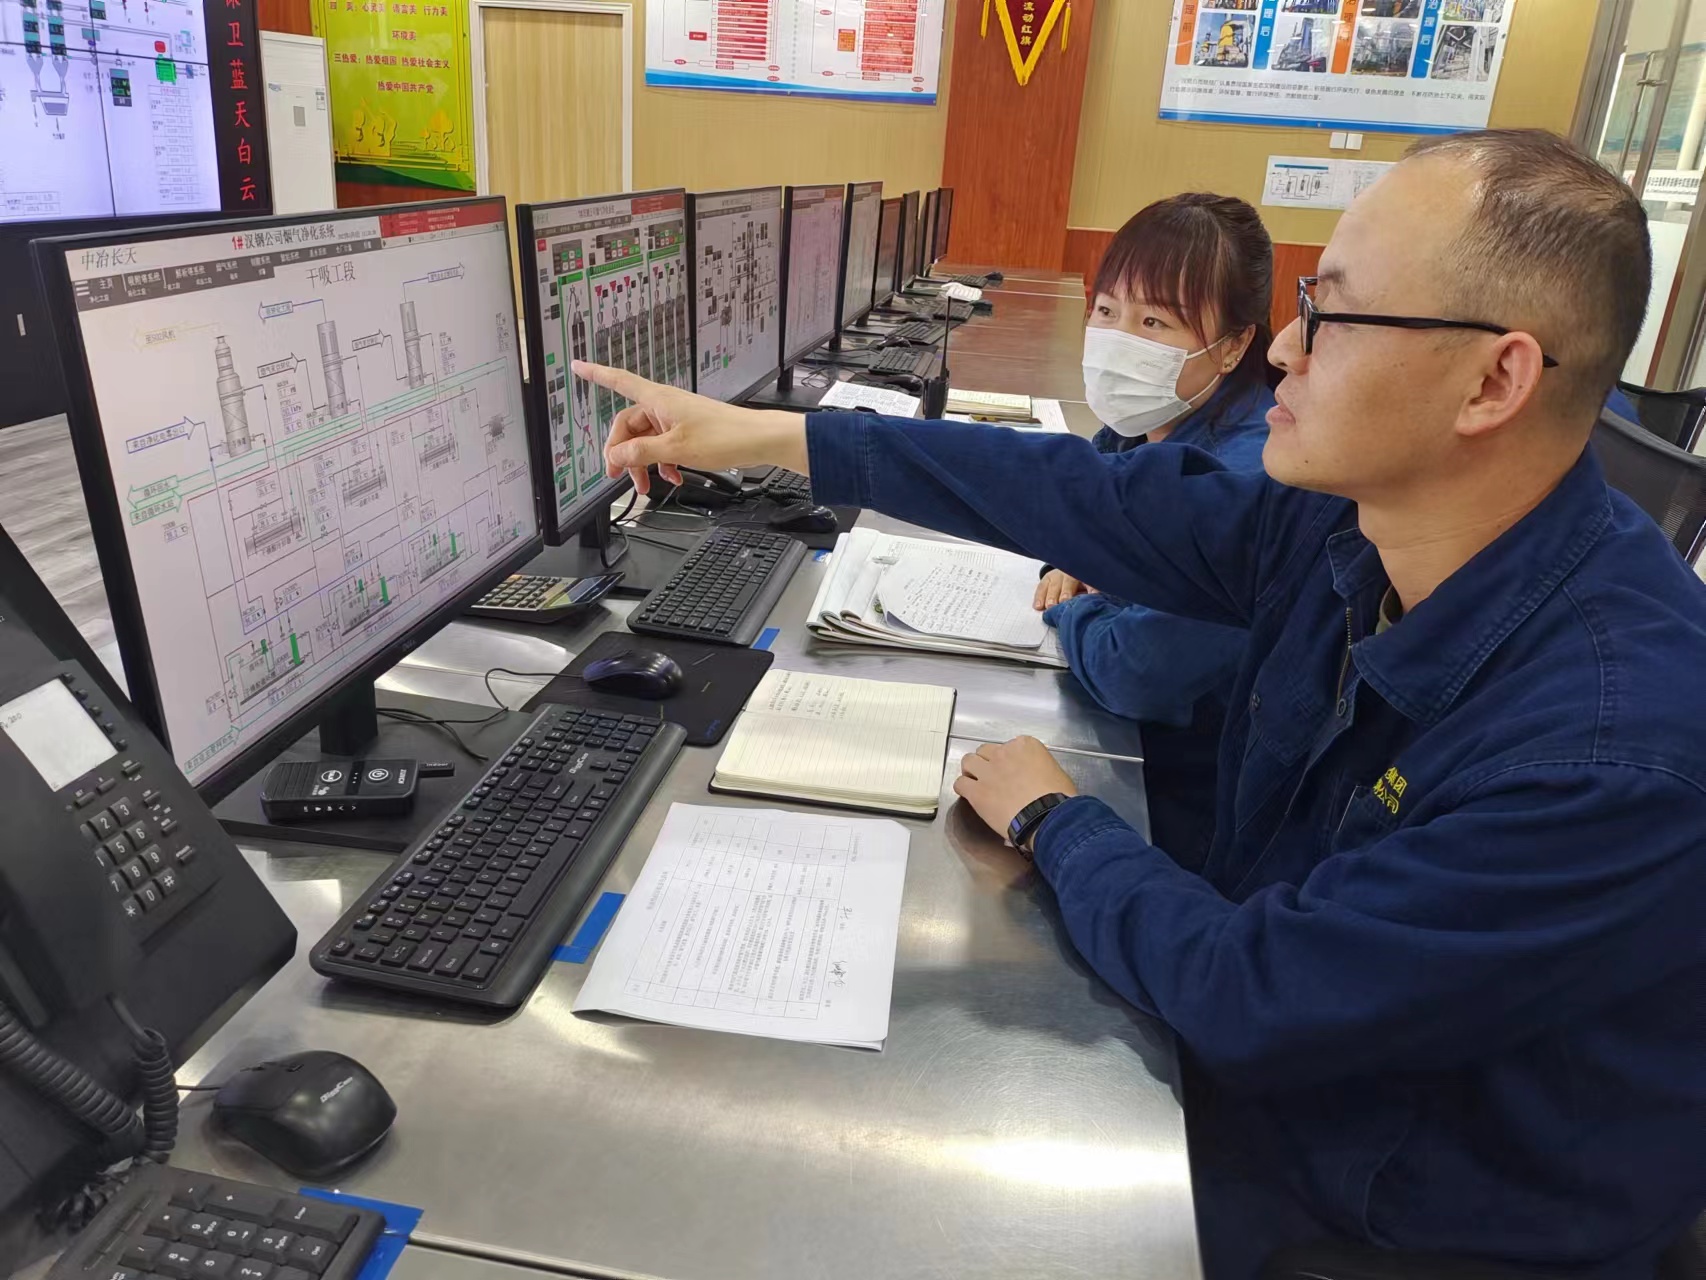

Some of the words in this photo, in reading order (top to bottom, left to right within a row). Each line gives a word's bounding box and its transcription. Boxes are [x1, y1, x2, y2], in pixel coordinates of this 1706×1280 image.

[377, 81, 434, 94] 热爱中国共产党
[81, 247, 137, 271] 中冶长天
[305, 261, 356, 289] 干吸工段
[100, 817, 111, 830] 2
[119, 803, 130, 816] 3
[115, 841, 126, 854] 5
[135, 827, 145, 839] 6
[131, 865, 141, 878] 8
[150, 851, 160, 864] 9
[146, 889, 156, 902] 0
